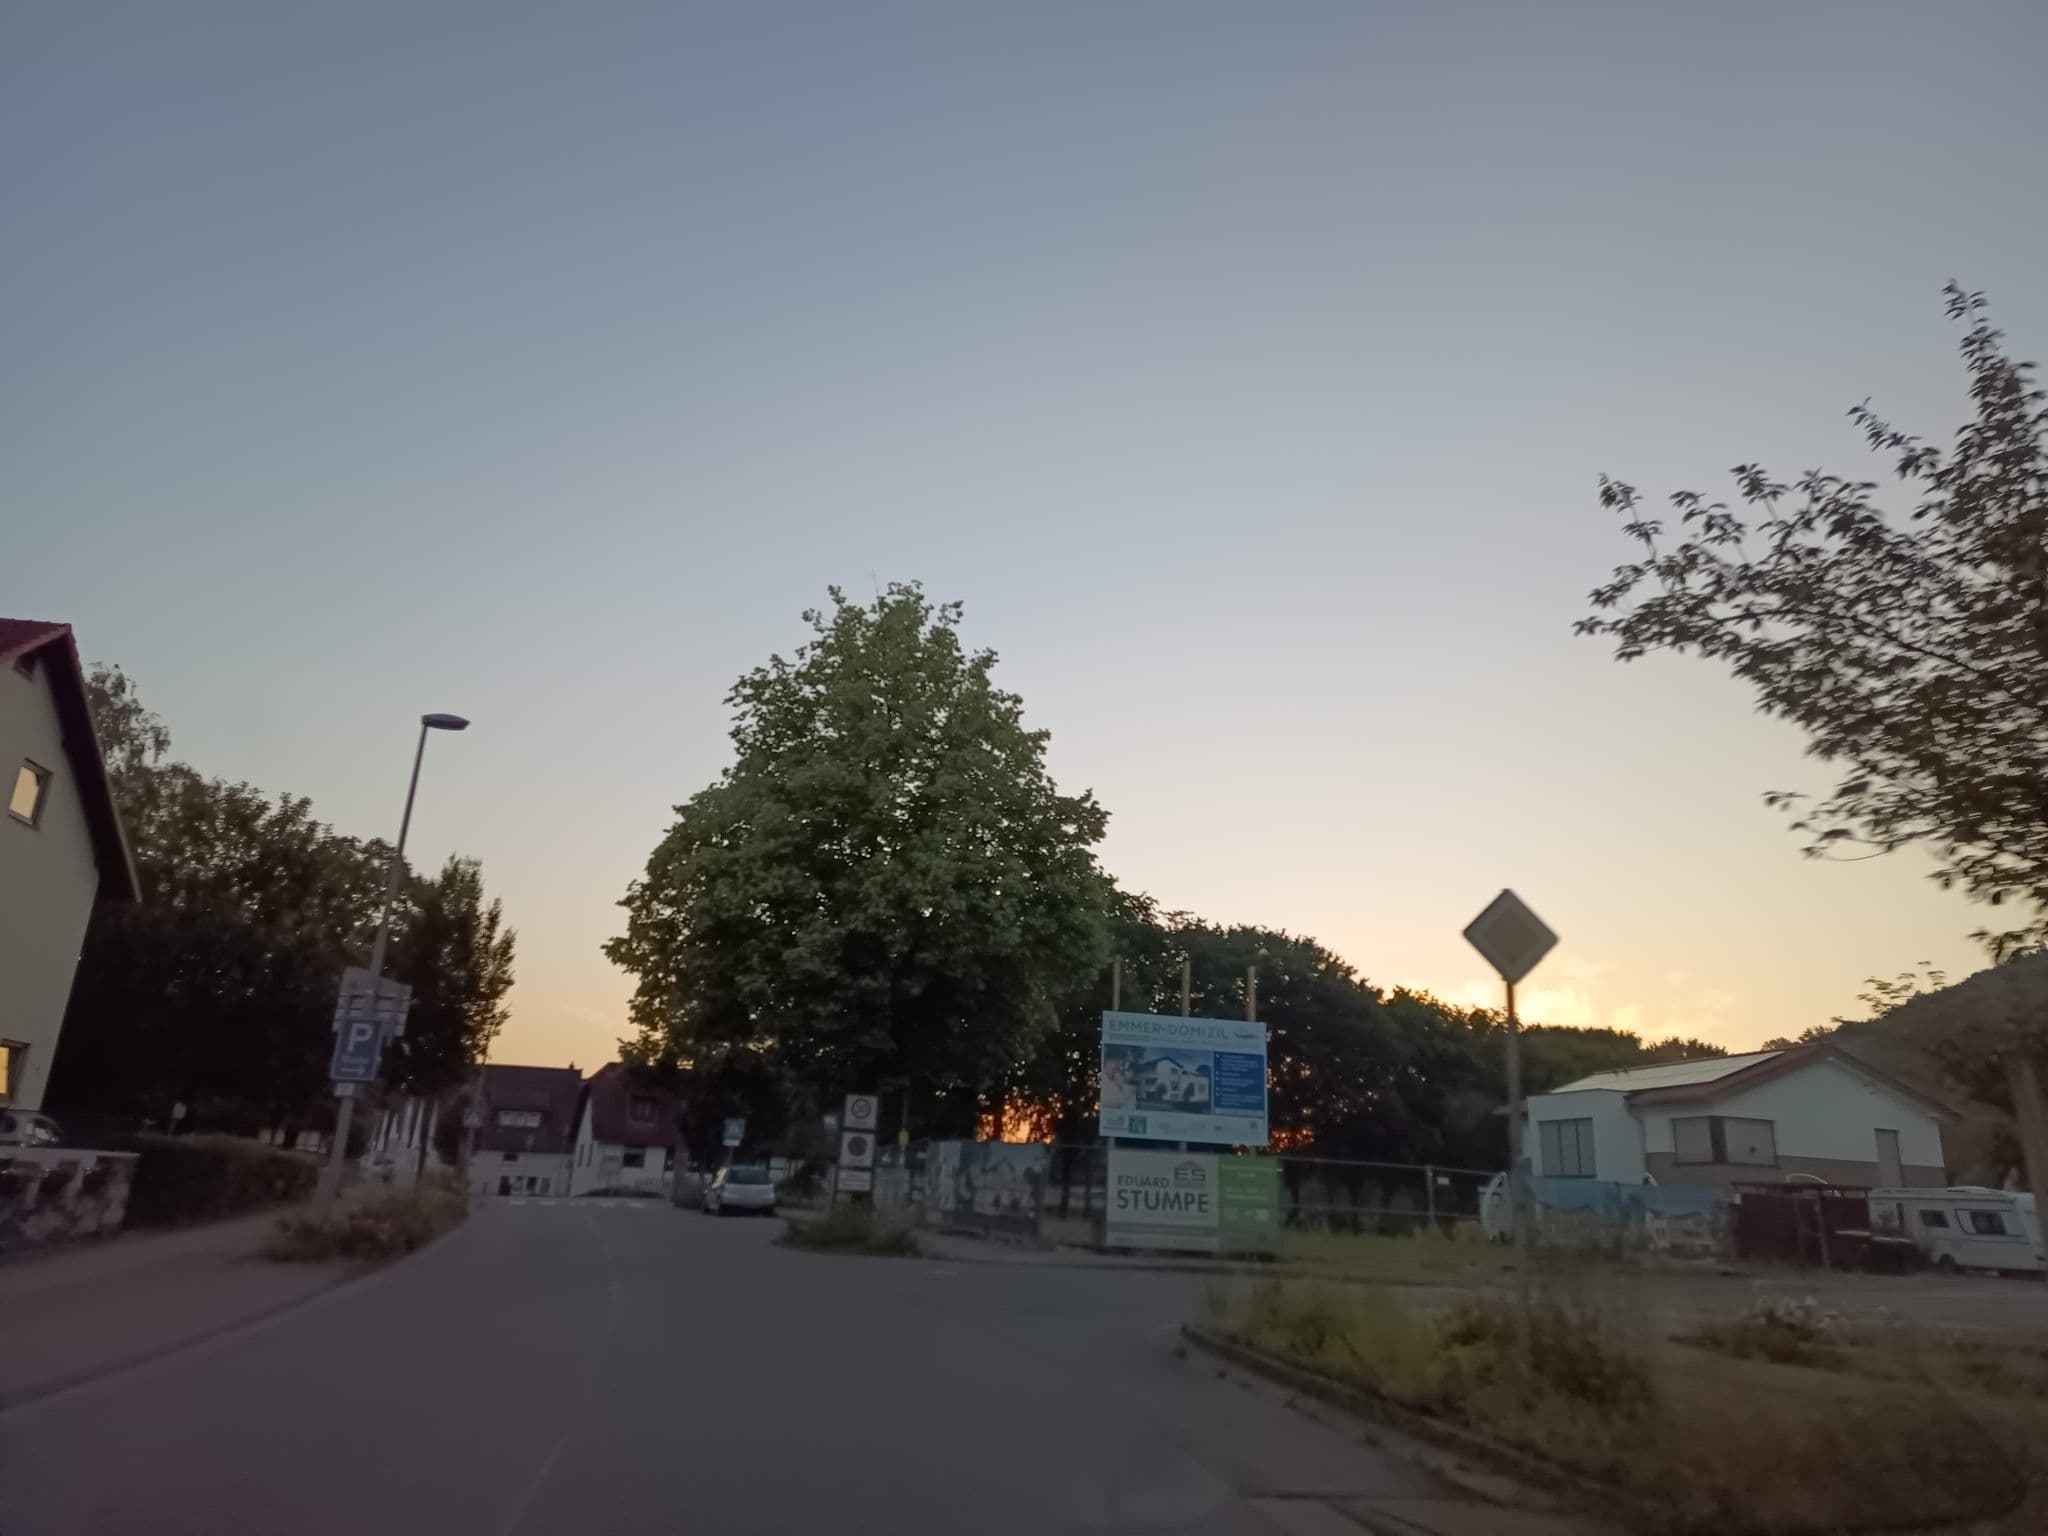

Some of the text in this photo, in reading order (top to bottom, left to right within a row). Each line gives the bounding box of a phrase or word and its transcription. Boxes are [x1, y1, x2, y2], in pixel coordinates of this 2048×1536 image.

[347, 1023, 373, 1053] P
[1109, 1020, 1230, 1039] EMMER-DOMIZIL
[1117, 1175, 1169, 1188] EDUARD
[1174, 1167, 1206, 1182] ES
[1117, 1189, 1209, 1213] STUMPE
